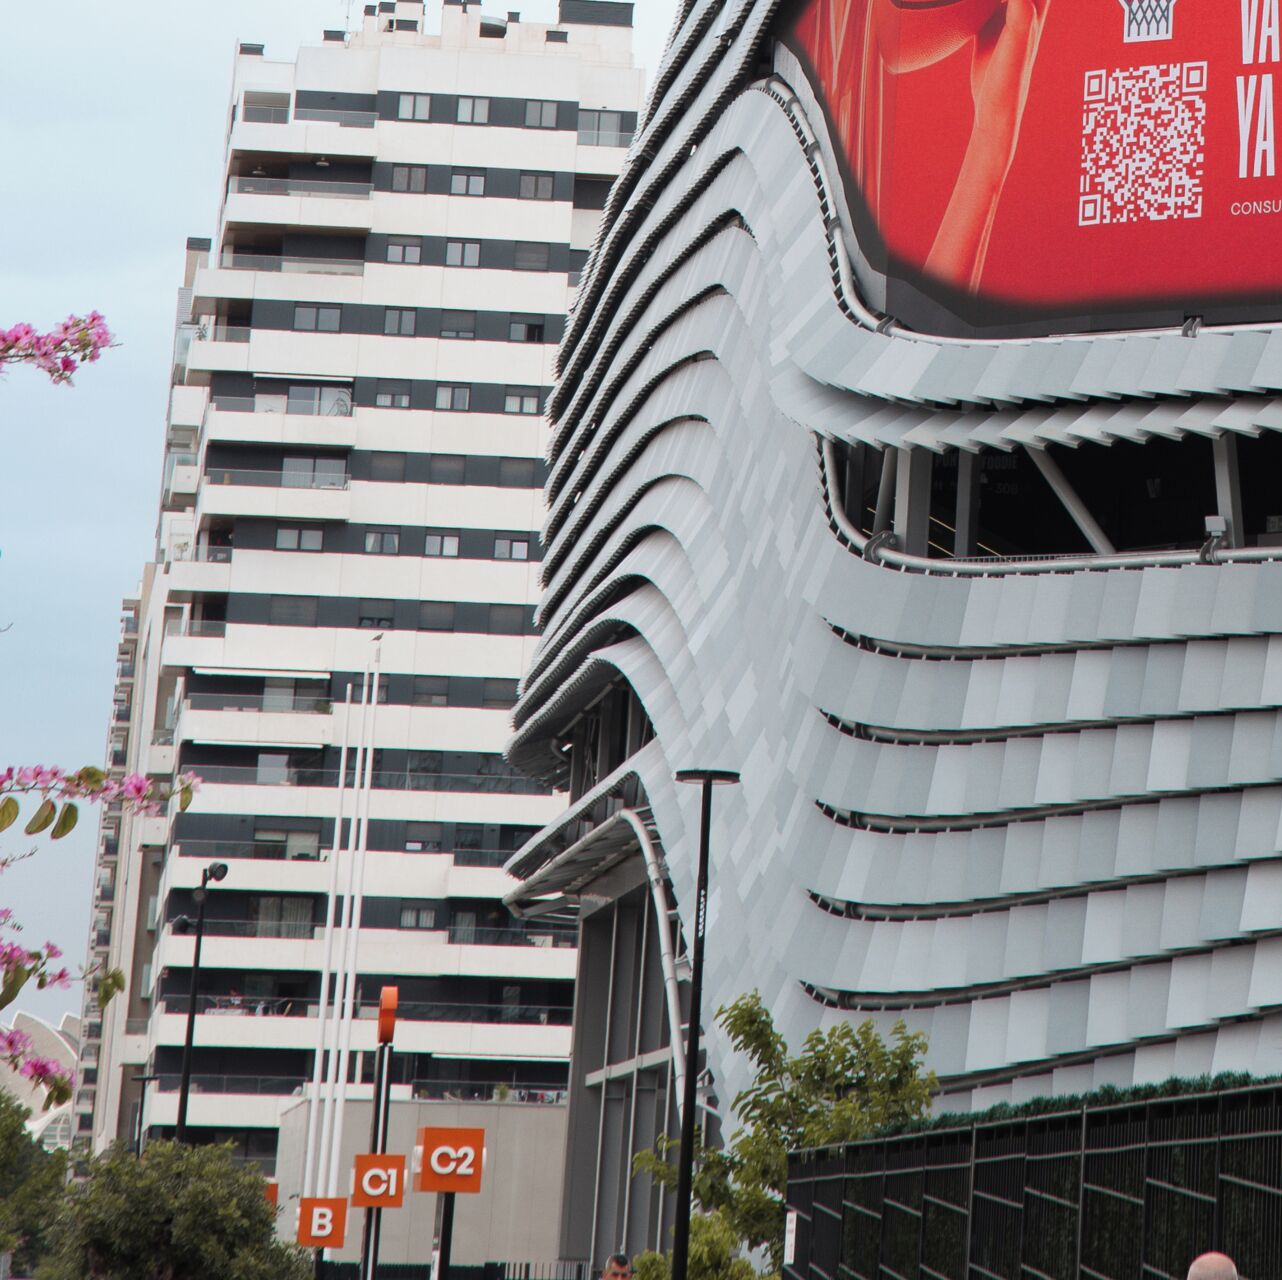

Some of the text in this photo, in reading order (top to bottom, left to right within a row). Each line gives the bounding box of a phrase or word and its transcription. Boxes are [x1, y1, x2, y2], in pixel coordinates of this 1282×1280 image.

[1235, 73, 1276, 179] YA
[430, 1145, 476, 1176] C2
[361, 1167, 397, 1197] C1
[310, 1206, 333, 1237] B
